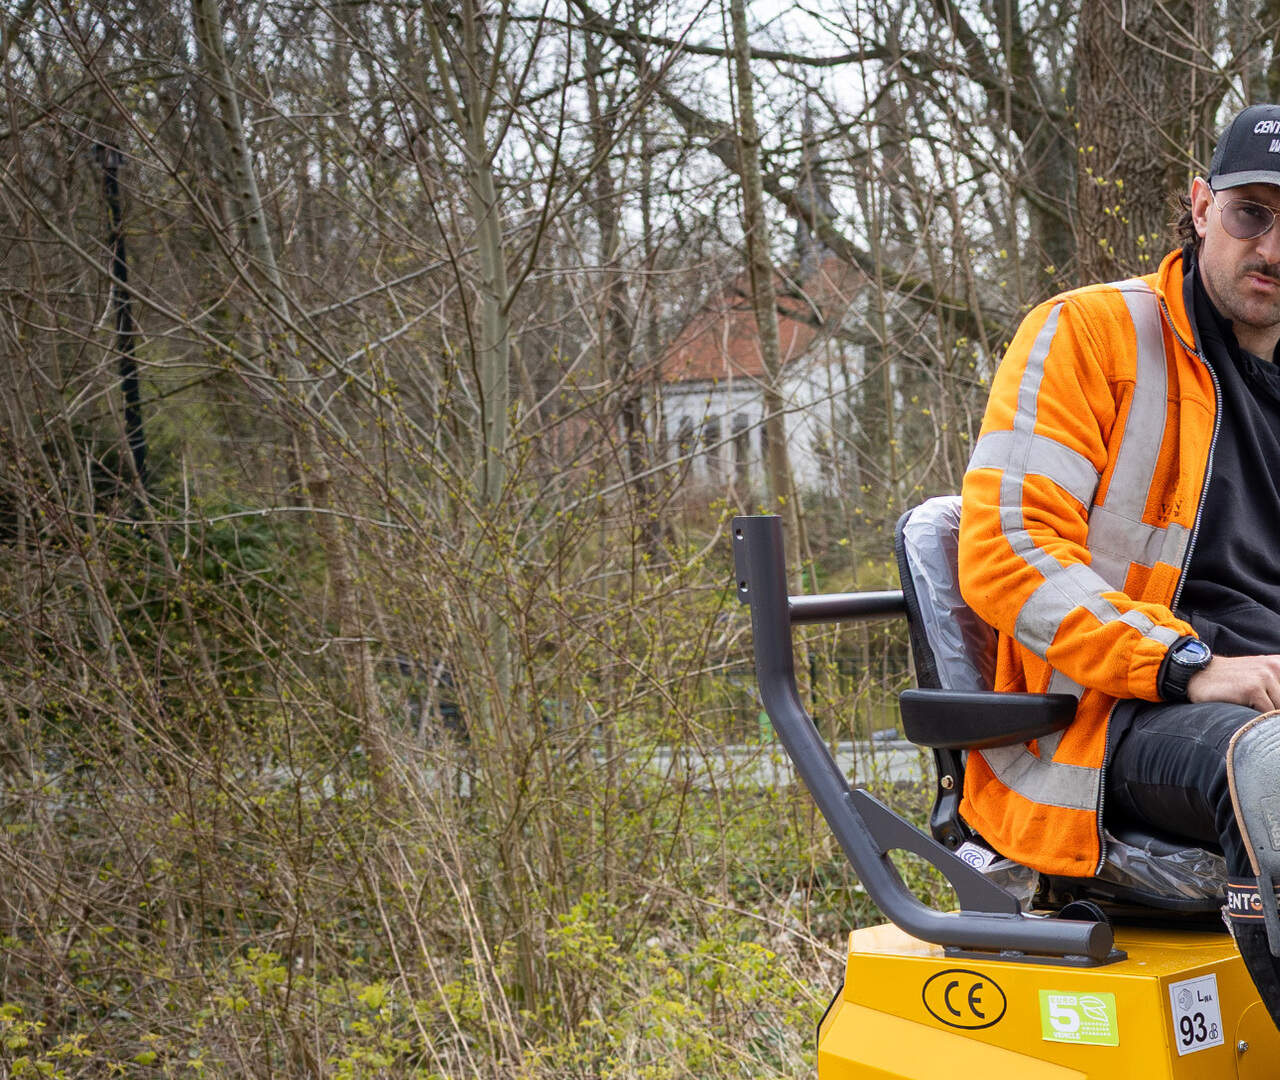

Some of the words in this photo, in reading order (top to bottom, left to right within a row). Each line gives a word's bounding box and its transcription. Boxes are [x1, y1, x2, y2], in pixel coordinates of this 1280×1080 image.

[1228, 891, 1264, 911] ENTO
[944, 980, 985, 1019] CE
[1048, 995, 1080, 1032] 5
[1180, 1012, 1208, 1046] 93
